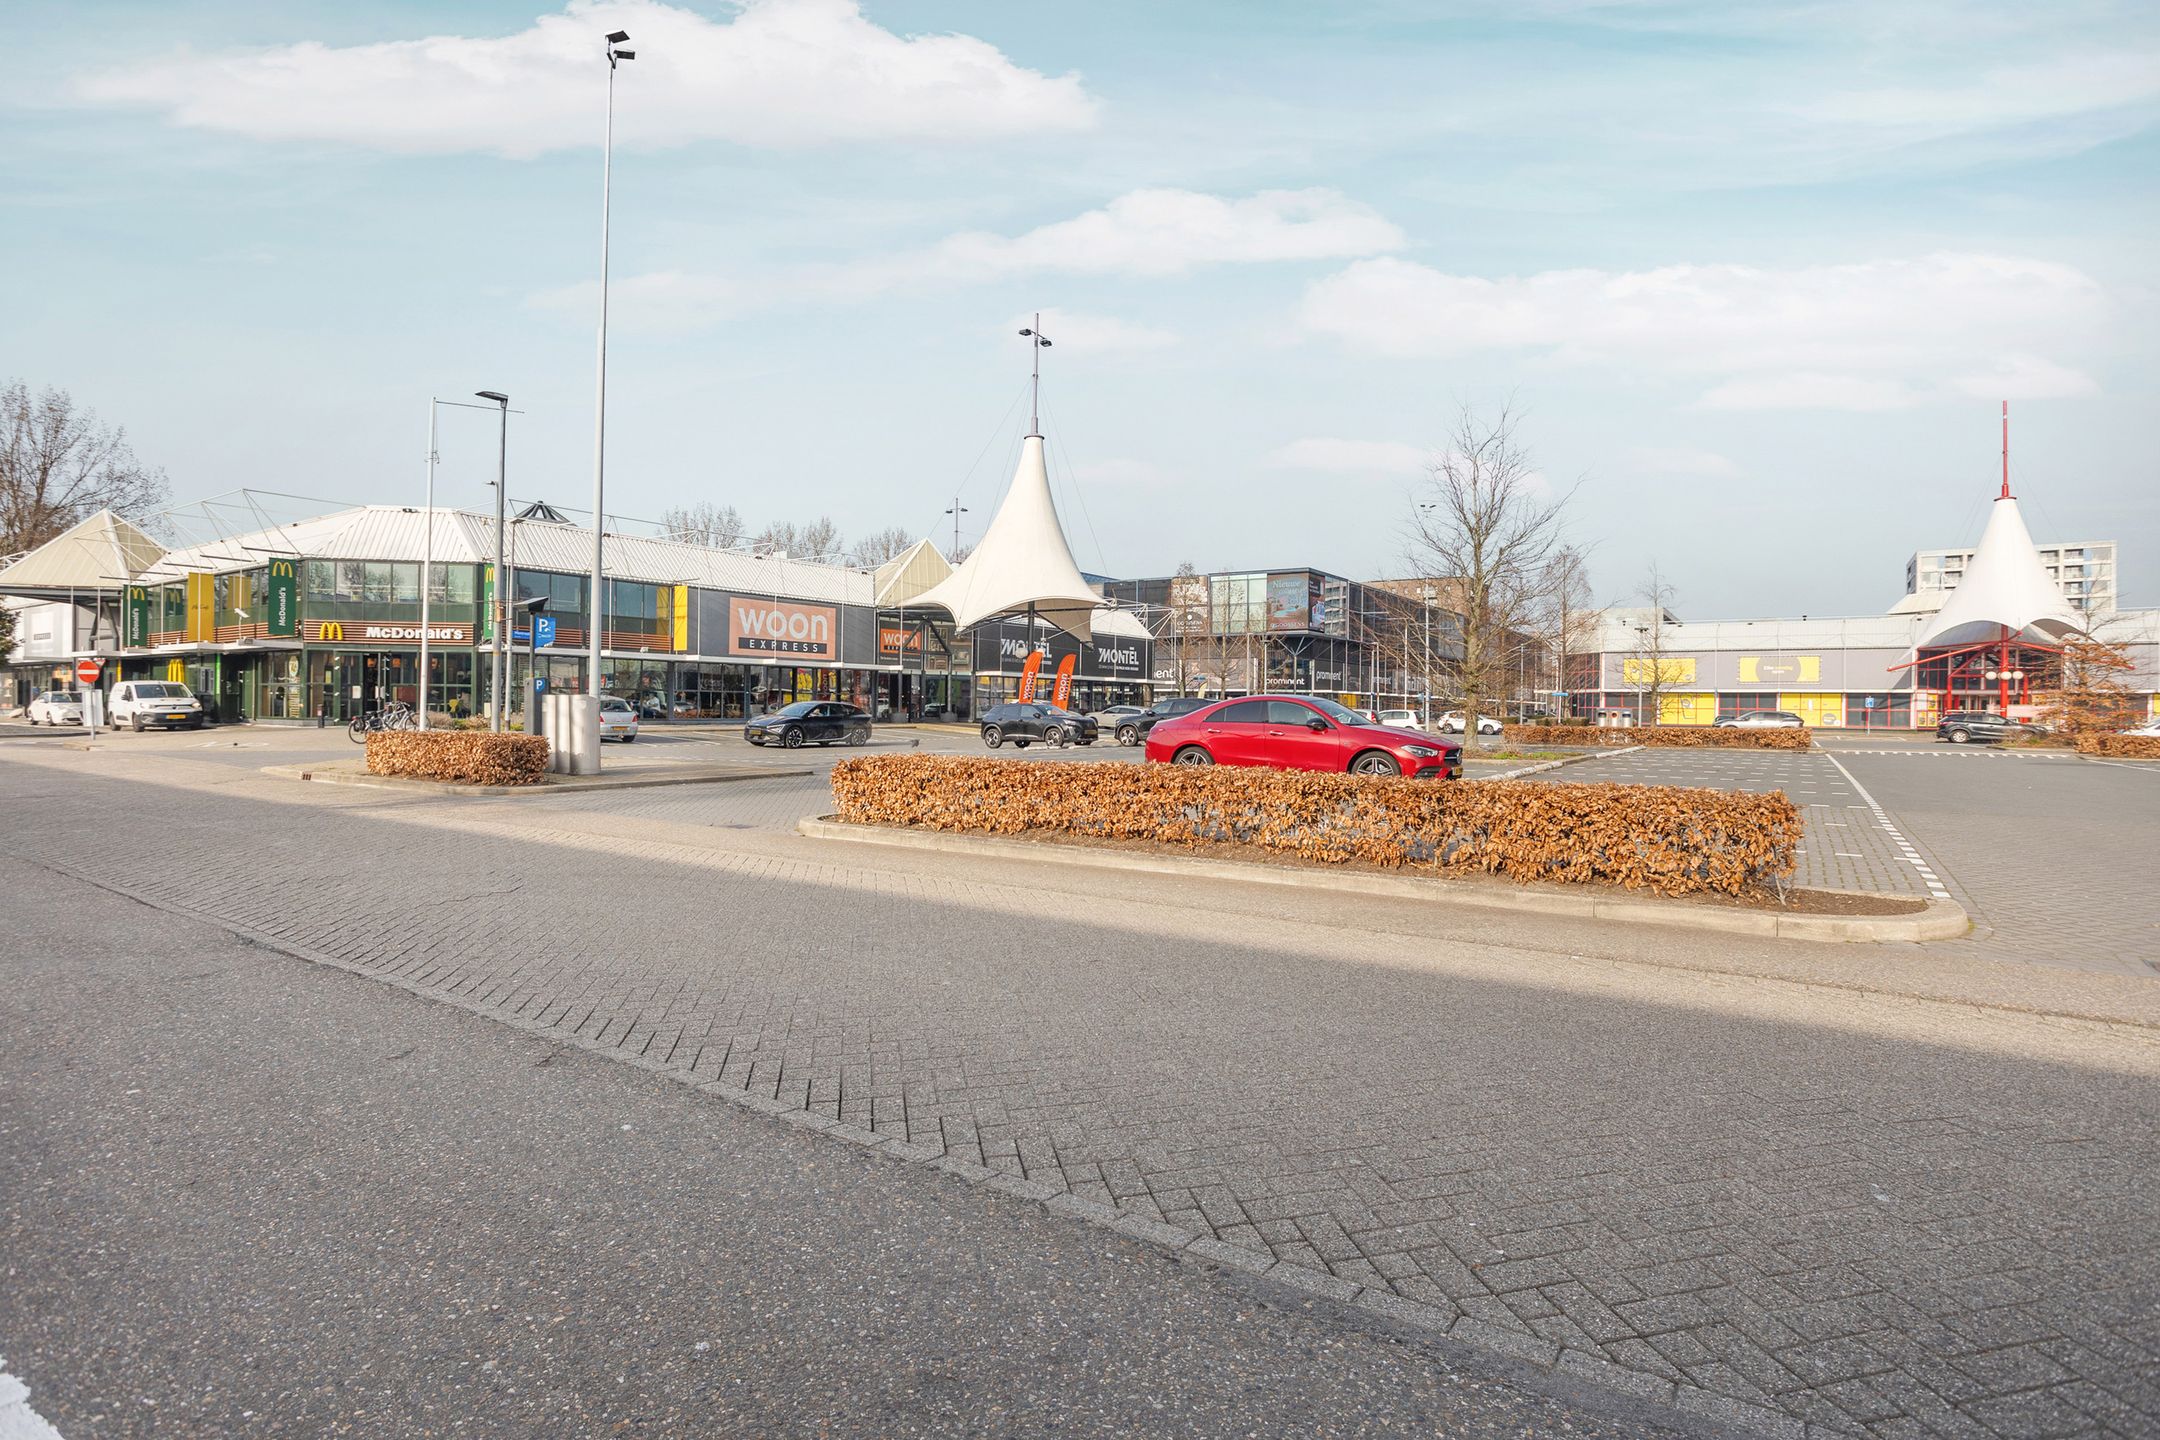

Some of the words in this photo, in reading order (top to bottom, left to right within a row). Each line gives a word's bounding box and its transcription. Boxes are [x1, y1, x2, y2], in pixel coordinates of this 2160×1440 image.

[278, 587, 287, 627] McDonald's
[132, 608, 140, 640] McDonald's
[365, 626, 464, 640] McDonald's
[539, 618, 549, 633] P
[738, 607, 828, 641] woon
[749, 639, 818, 653] EXPRESS
[536, 679, 543, 690] P
[1022, 671, 1035, 700] woon
[1058, 673, 1069, 701] woon
